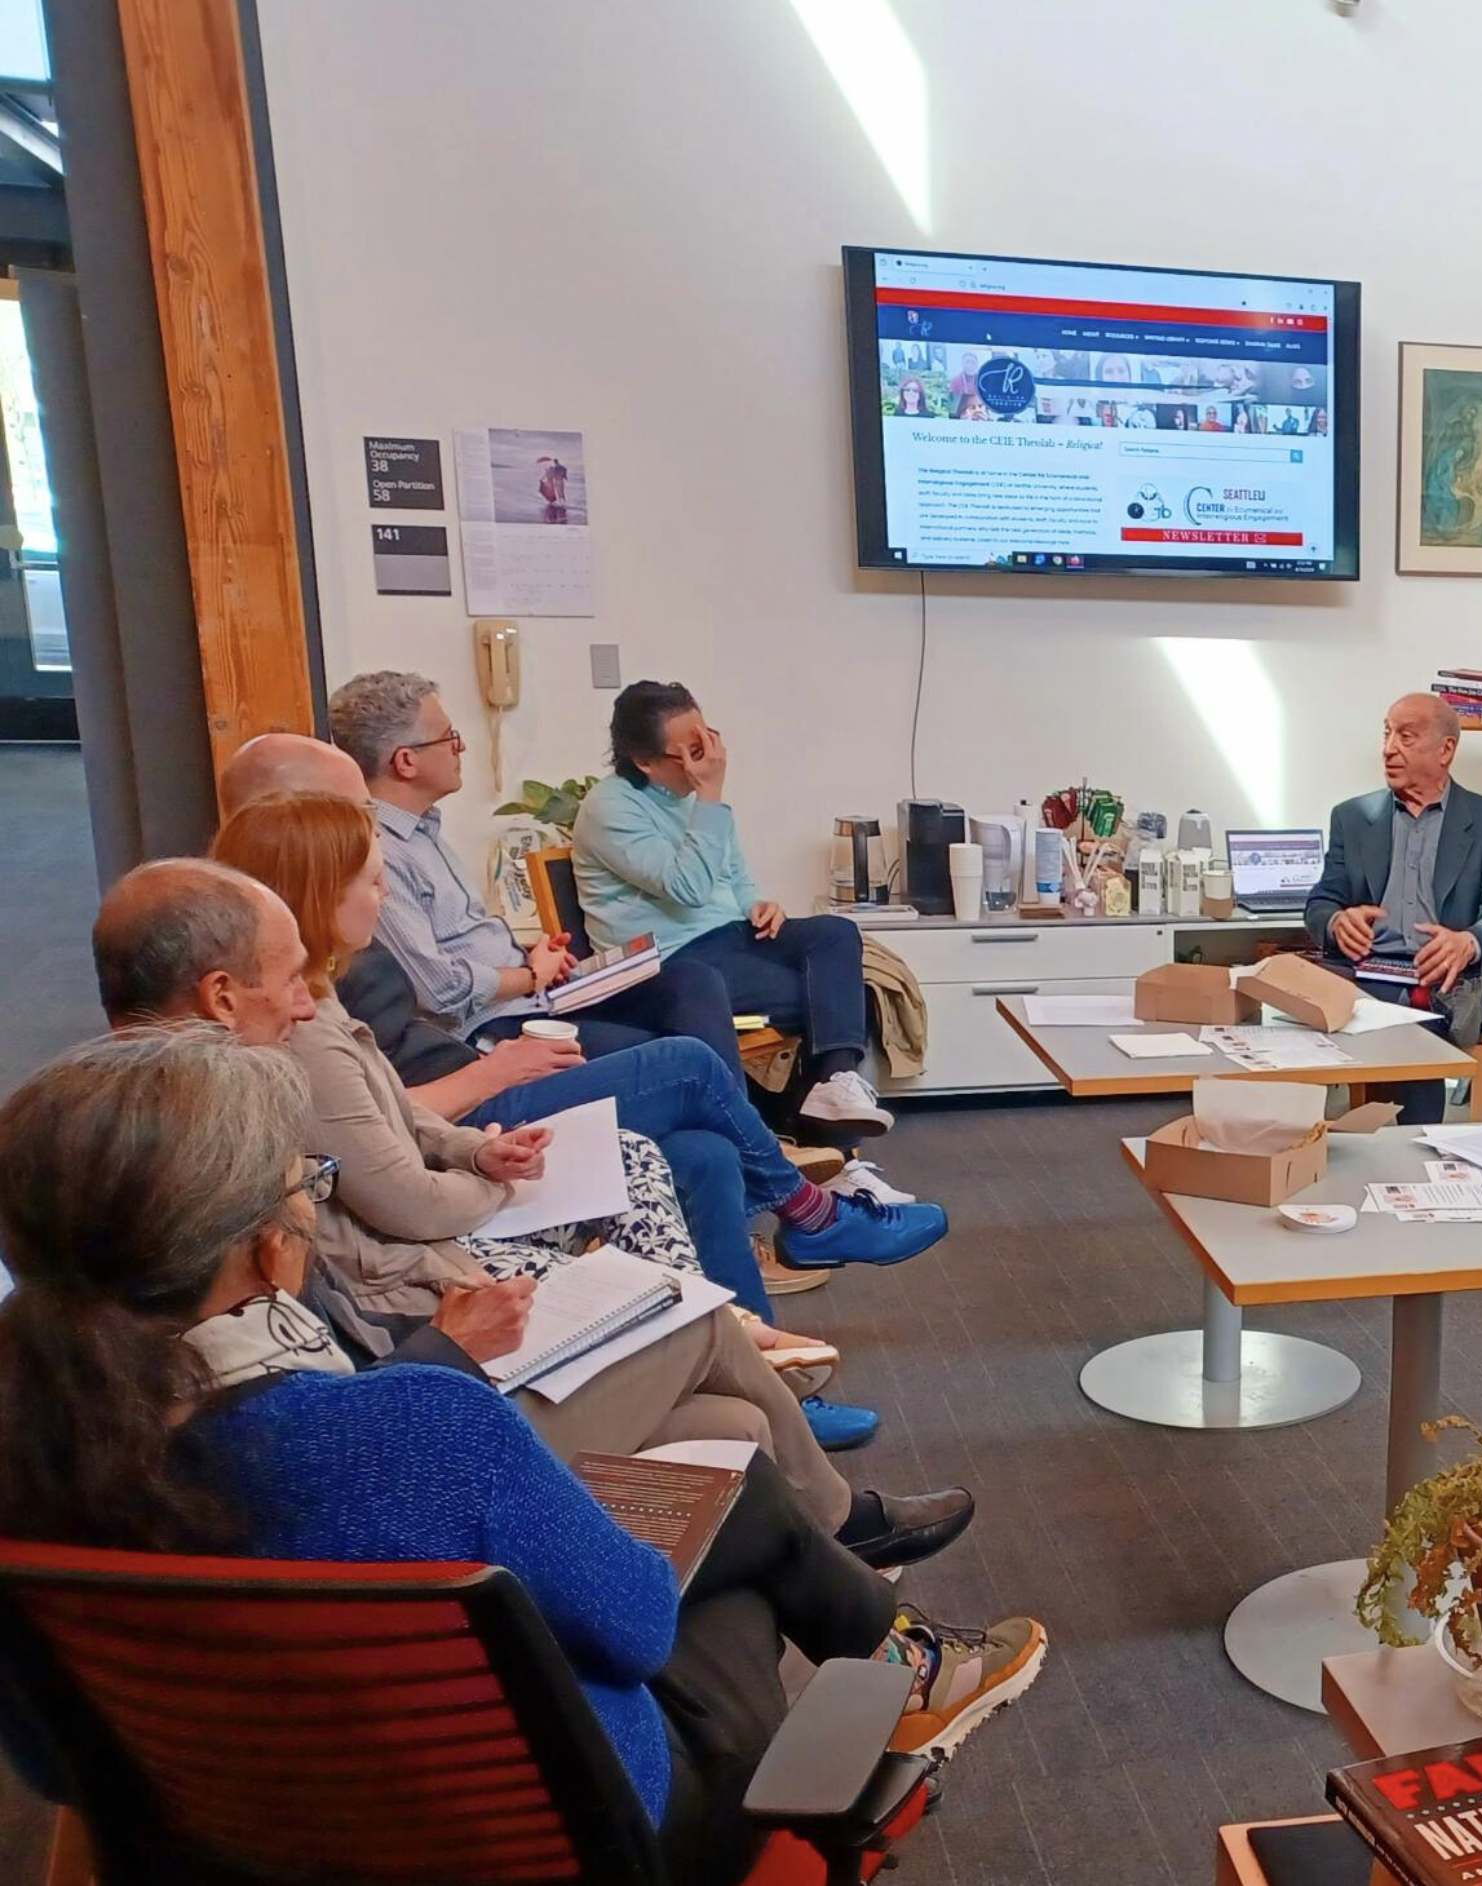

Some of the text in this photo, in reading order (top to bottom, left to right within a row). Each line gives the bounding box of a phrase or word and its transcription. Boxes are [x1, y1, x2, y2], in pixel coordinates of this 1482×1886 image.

[912, 432, 957, 443] Welcome
[960, 435, 970, 443] to
[972, 434, 987, 444] the
[369, 441, 415, 451] Maximum
[370, 450, 420, 462] Occupancy
[371, 460, 389, 472] 38
[373, 480, 435, 490] Open Partition
[373, 489, 390, 502] 58
[1196, 503, 1225, 512] CENTER
[1244, 514, 1289, 522] Engagement
[376, 527, 400, 541] 141
[1162, 530, 1249, 543] NEWSLETTER
